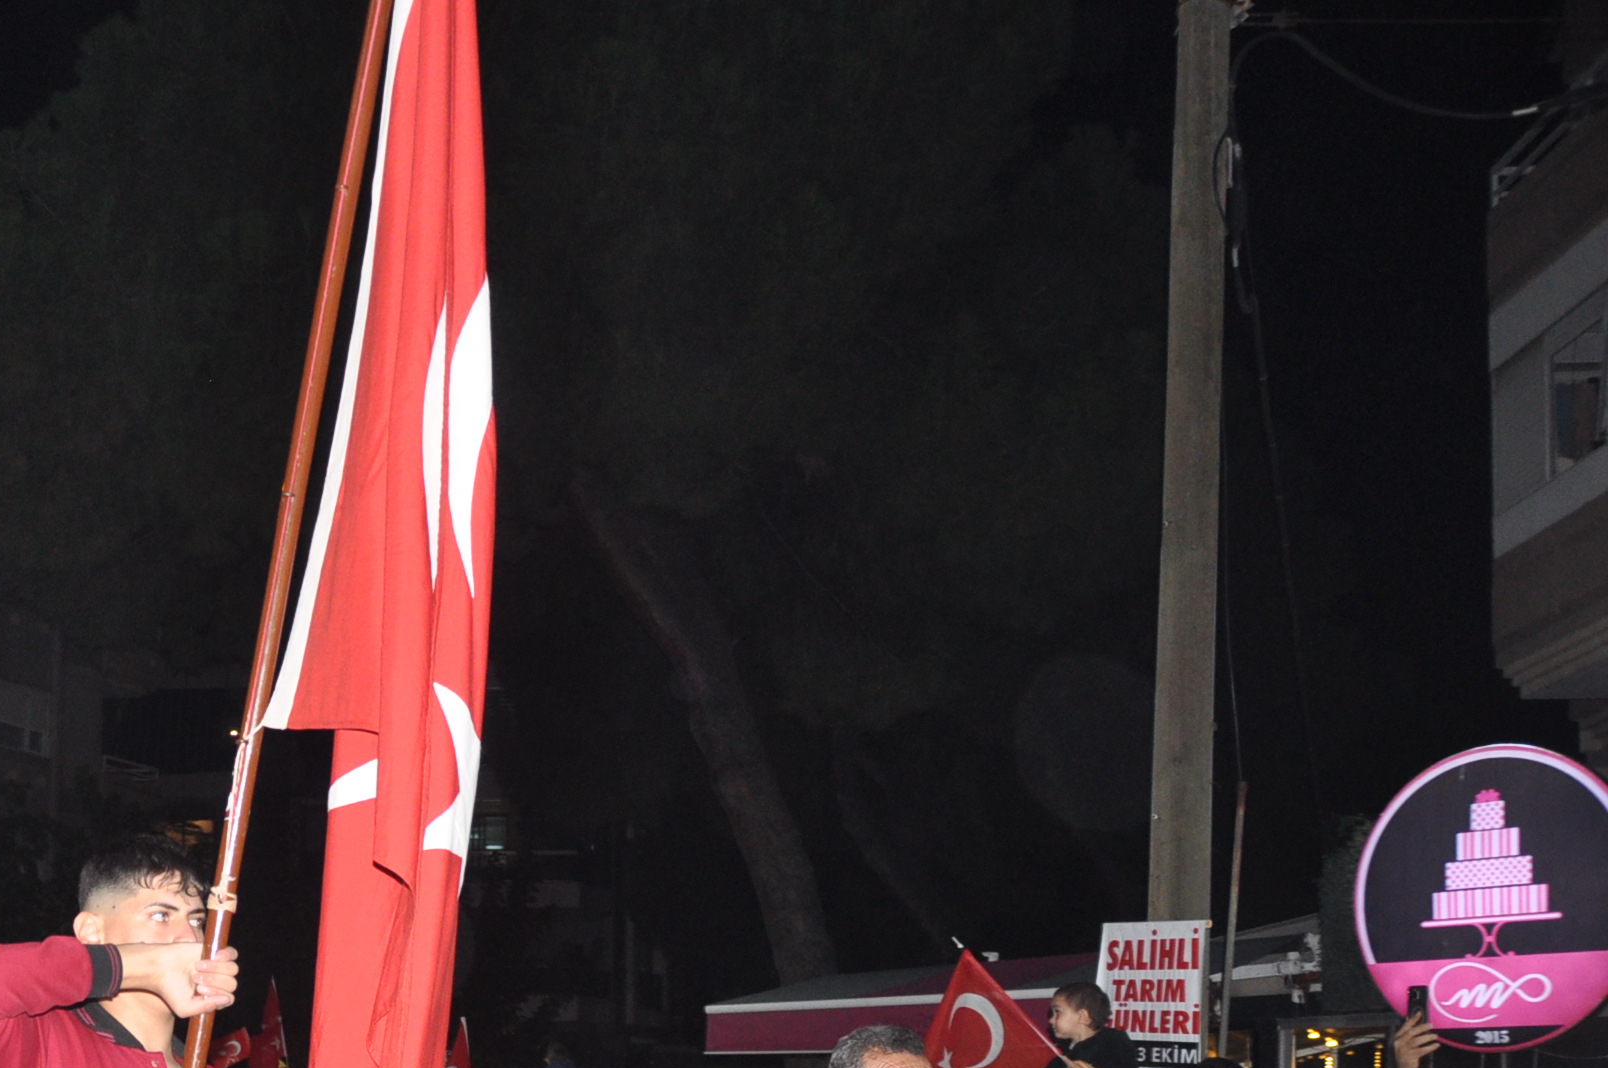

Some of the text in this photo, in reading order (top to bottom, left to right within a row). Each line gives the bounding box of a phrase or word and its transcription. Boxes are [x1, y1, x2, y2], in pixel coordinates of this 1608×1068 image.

[1106, 928, 1200, 971] SALİHLİ
[1112, 978, 1187, 1003] TARIM
[1475, 1030, 1510, 1044] 2015
[1152, 1045, 1198, 1064] EKİM
